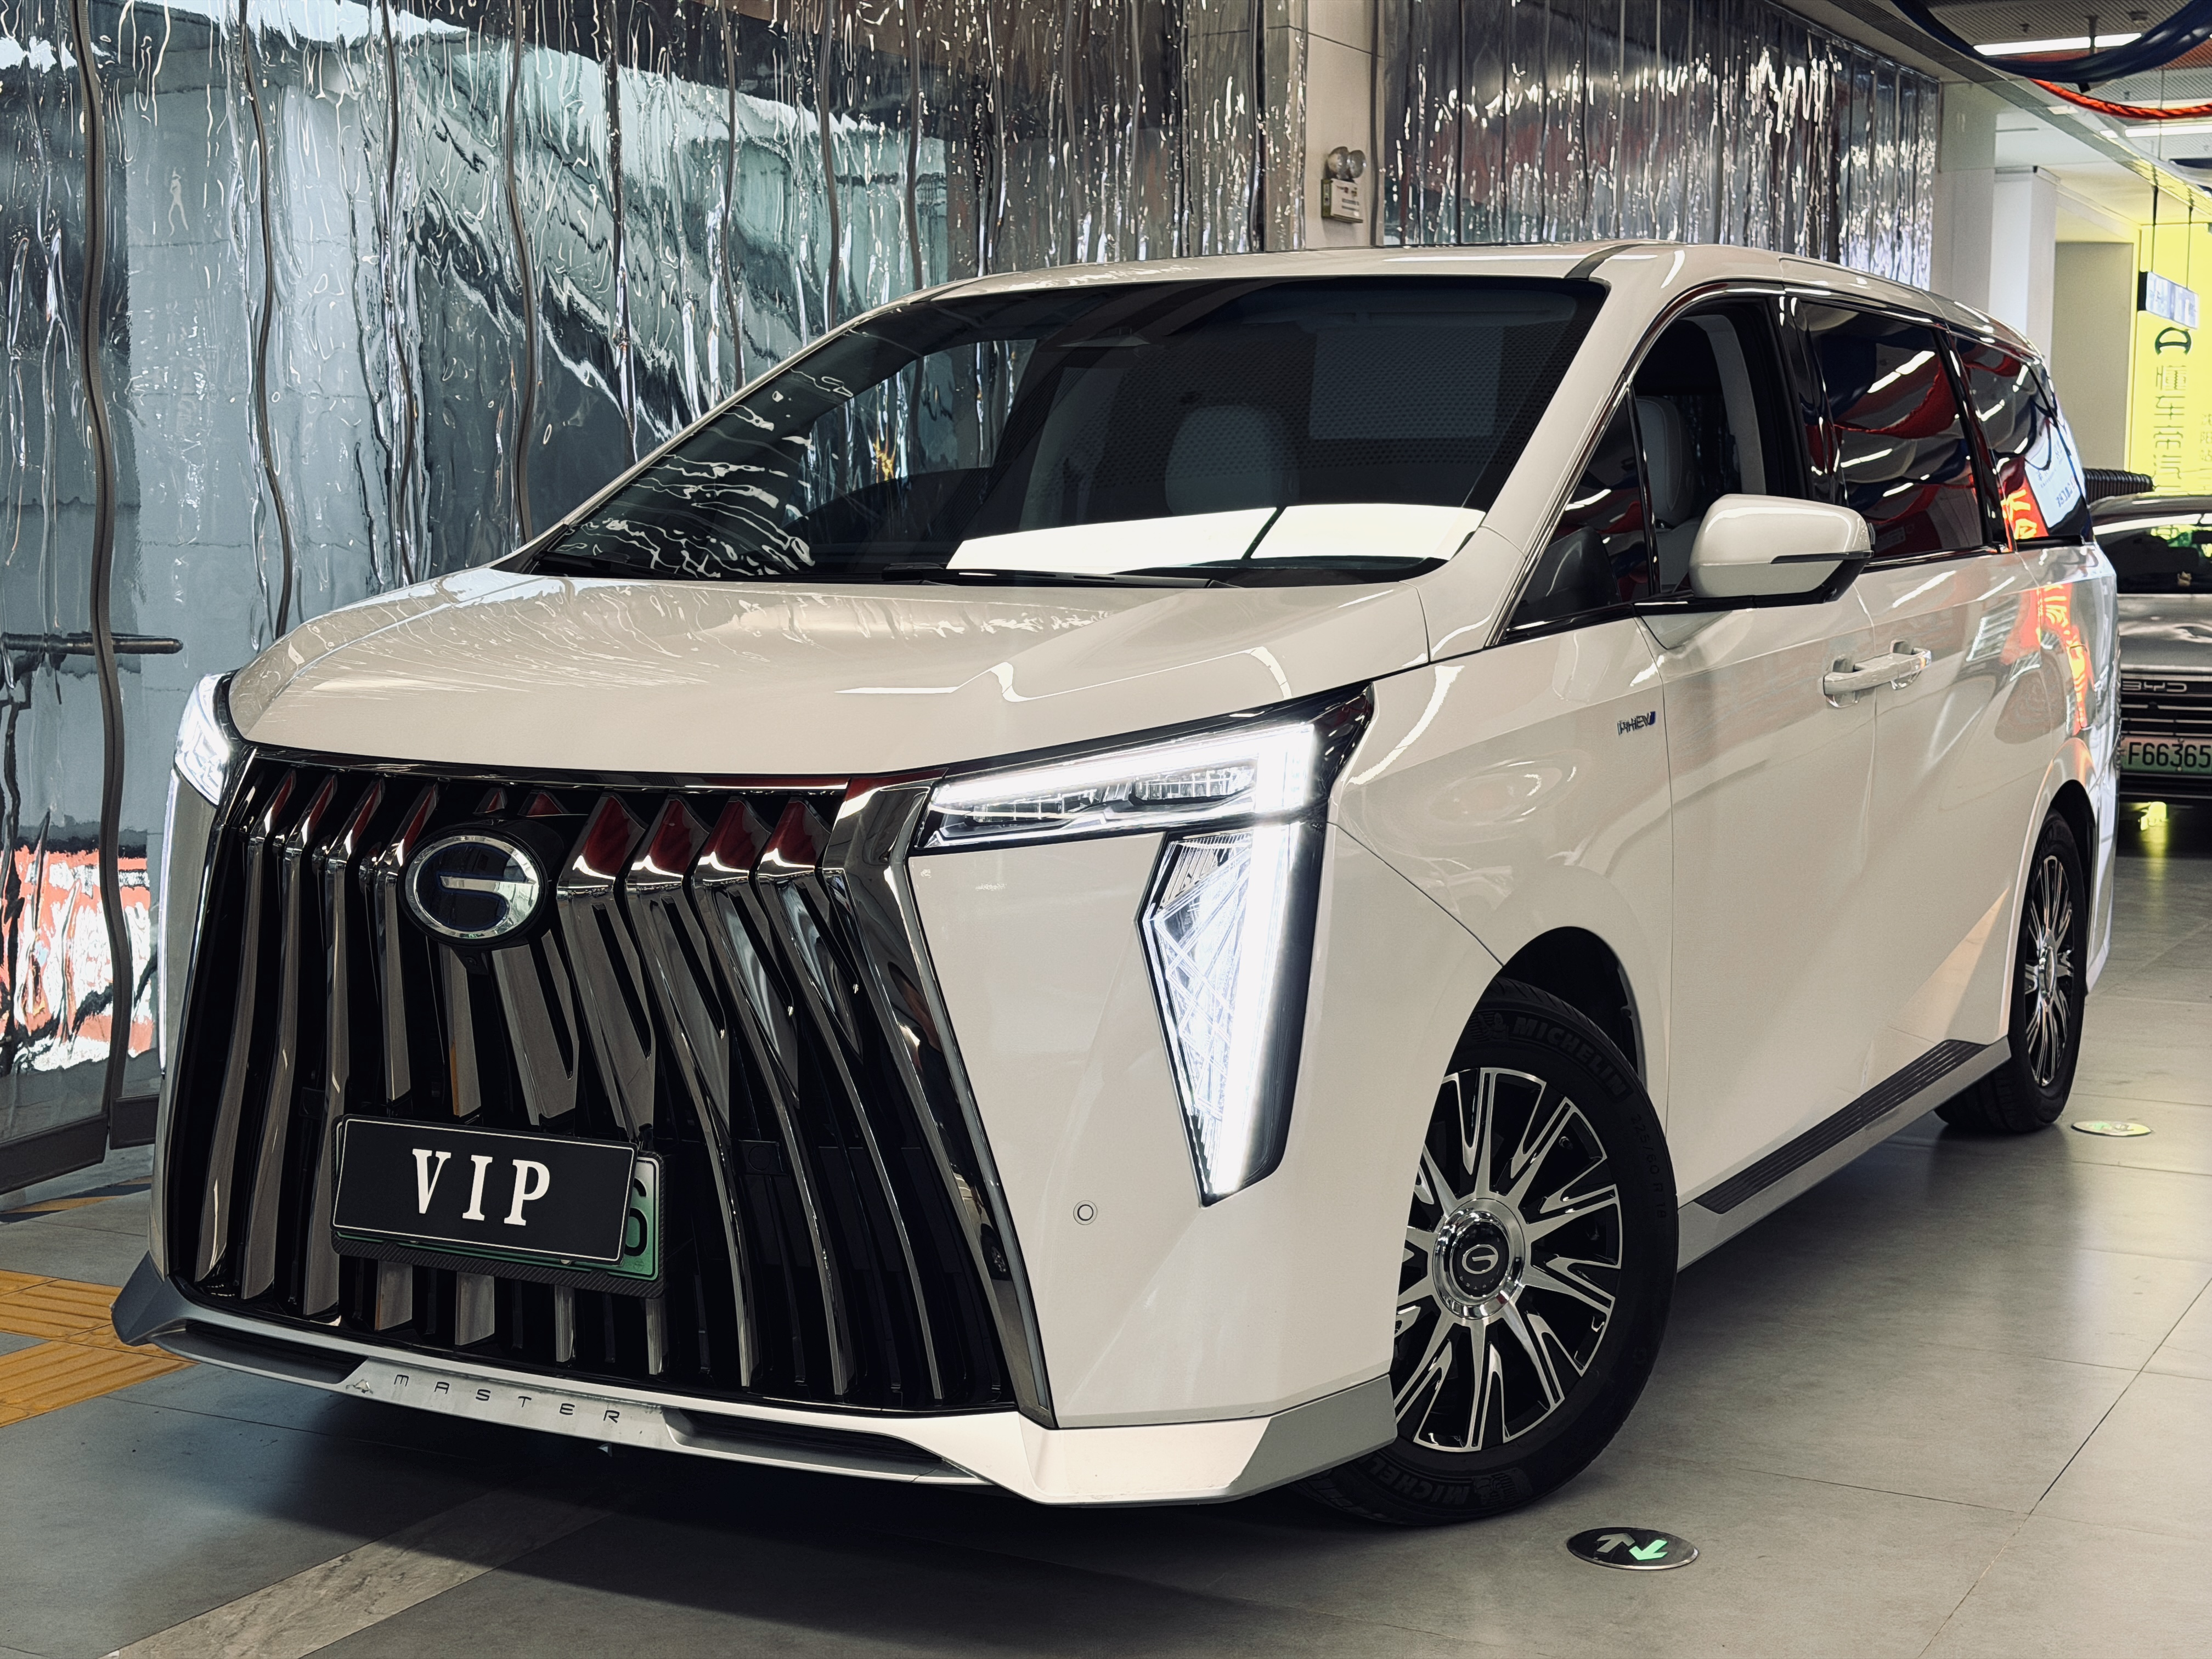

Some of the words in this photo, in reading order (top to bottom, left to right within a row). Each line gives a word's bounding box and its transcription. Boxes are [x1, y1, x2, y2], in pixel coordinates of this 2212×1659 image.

[2152, 365, 2187, 490] 懂车帝汽
[2122, 680, 2188, 693] BYD
[1617, 711, 1656, 736] PHEV
[2128, 742, 2211, 768] F66365
[1512, 1016, 1628, 1098] MICHELIN
[411, 1148, 551, 1227] VIP
[393, 1373, 620, 1425] MASTER
